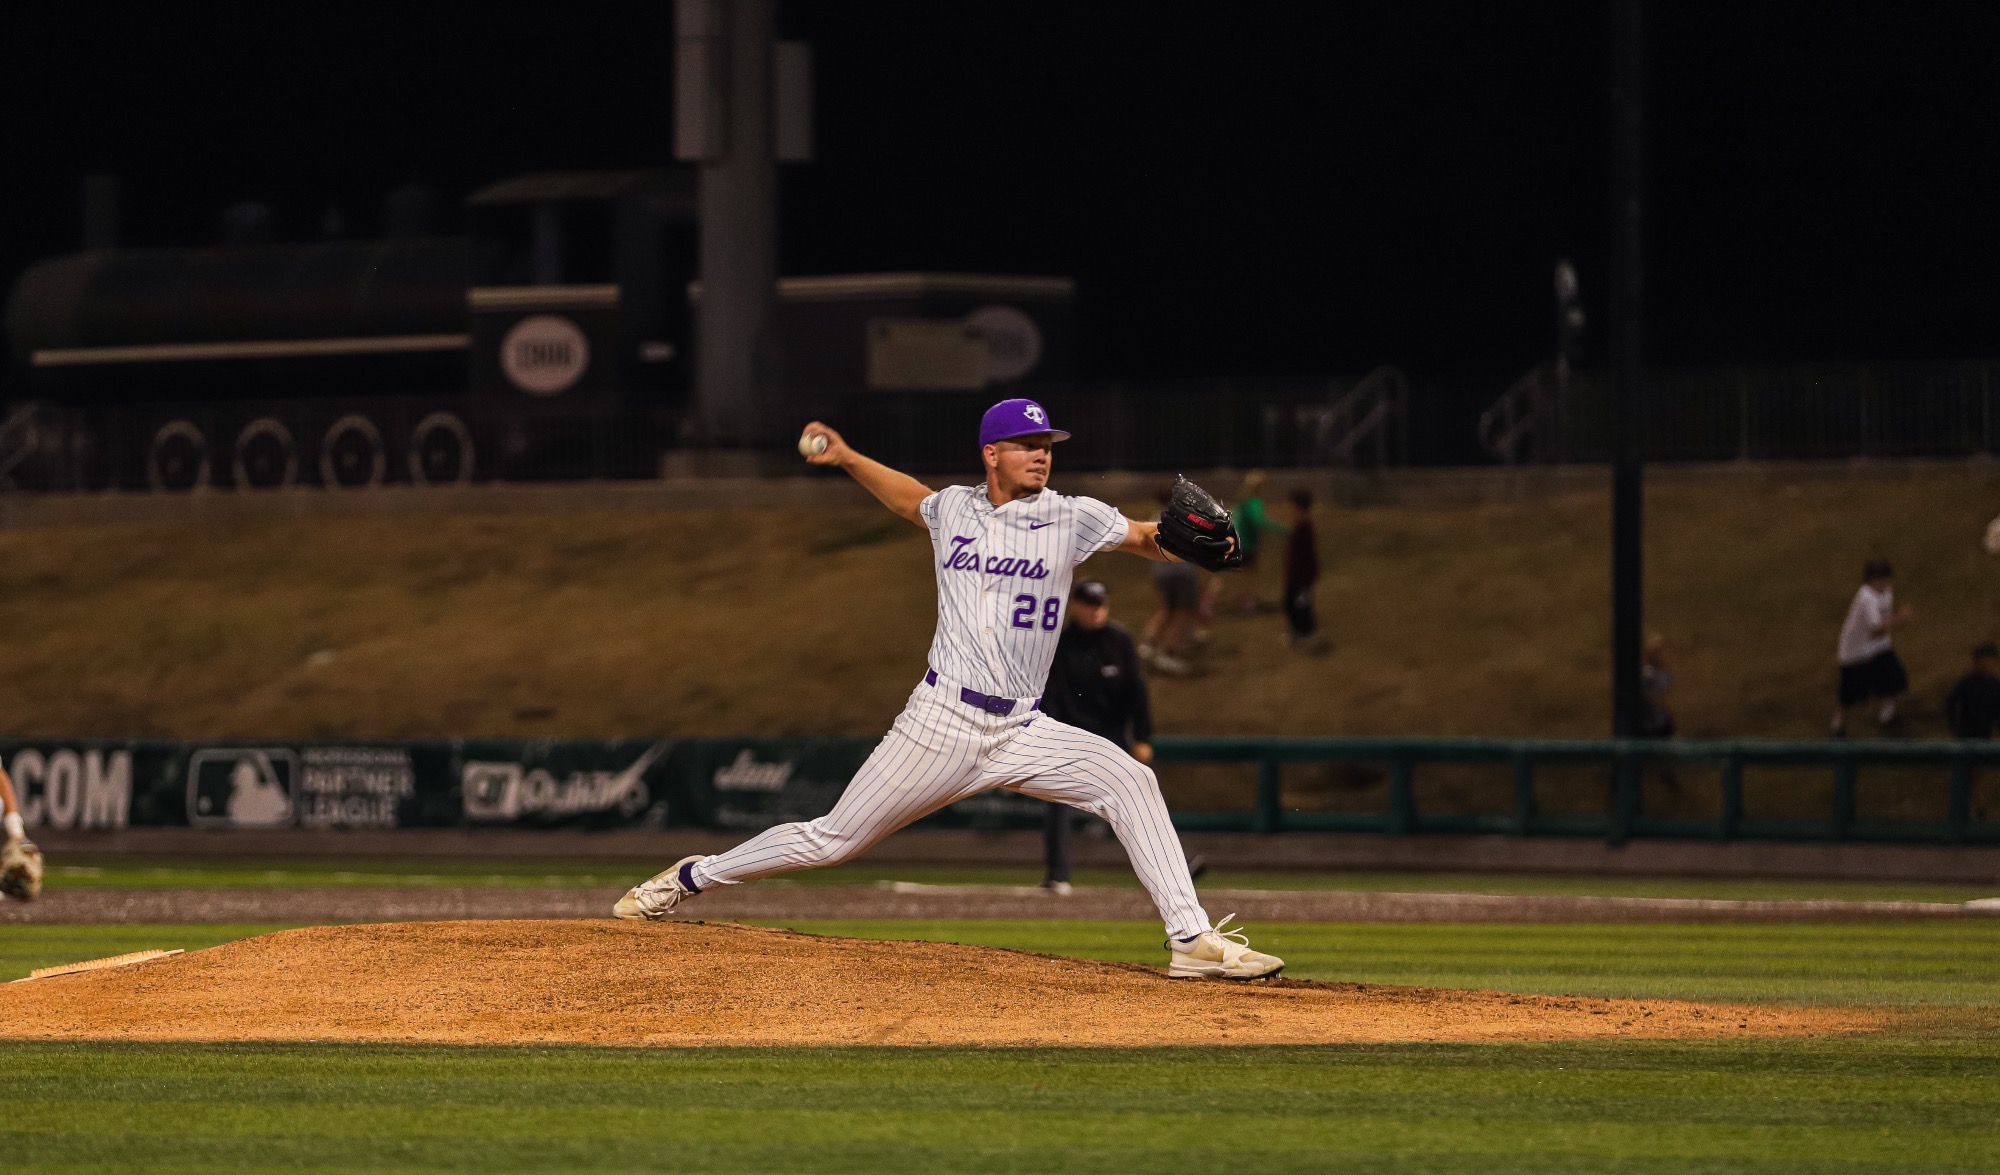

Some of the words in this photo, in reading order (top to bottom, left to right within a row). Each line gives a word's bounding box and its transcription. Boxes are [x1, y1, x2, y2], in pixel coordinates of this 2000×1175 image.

[1010, 593, 1061, 633] 28
[302, 766, 416, 797] PARTNER
[302, 794, 399, 823] LEAGUE
